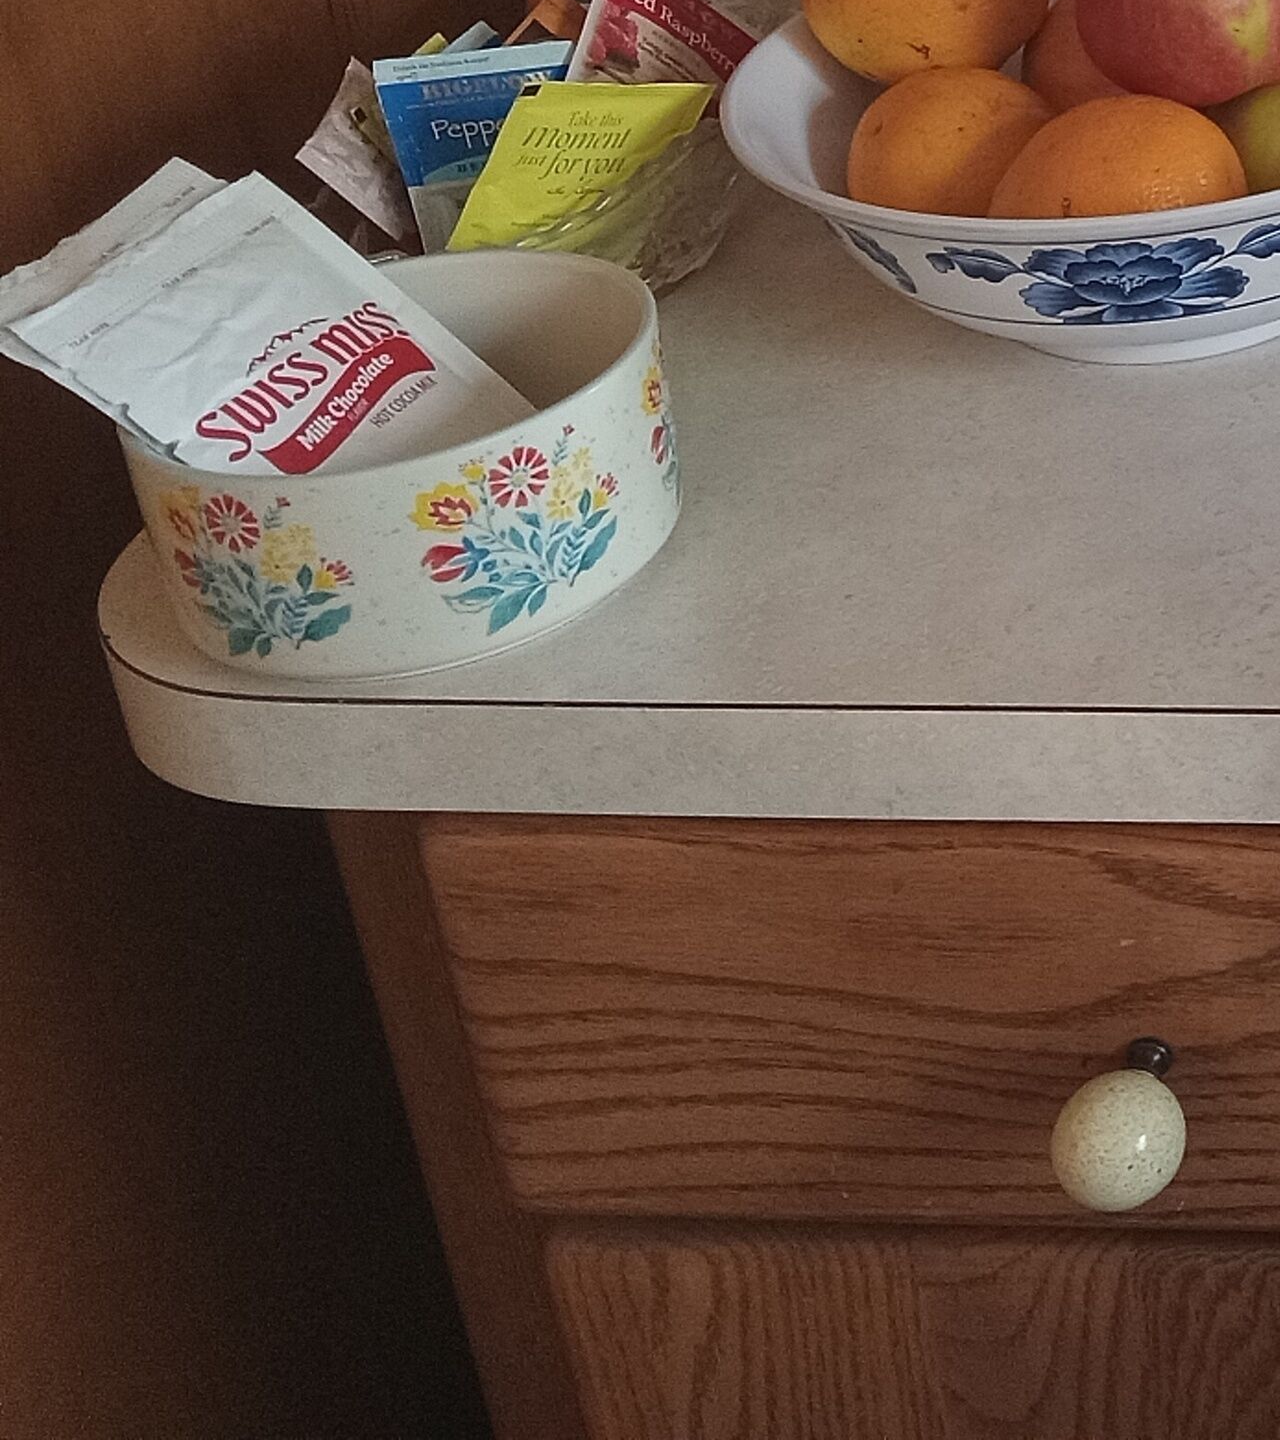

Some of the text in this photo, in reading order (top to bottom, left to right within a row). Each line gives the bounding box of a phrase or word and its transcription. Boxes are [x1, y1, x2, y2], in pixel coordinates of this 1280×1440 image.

[660, 4, 736, 71] Raspberr
[521, 126, 633, 150] Moment
[295, 351, 396, 452] Milk Chocolate
[369, 406, 392, 429] HOT
[389, 384, 423, 414] COCOA
